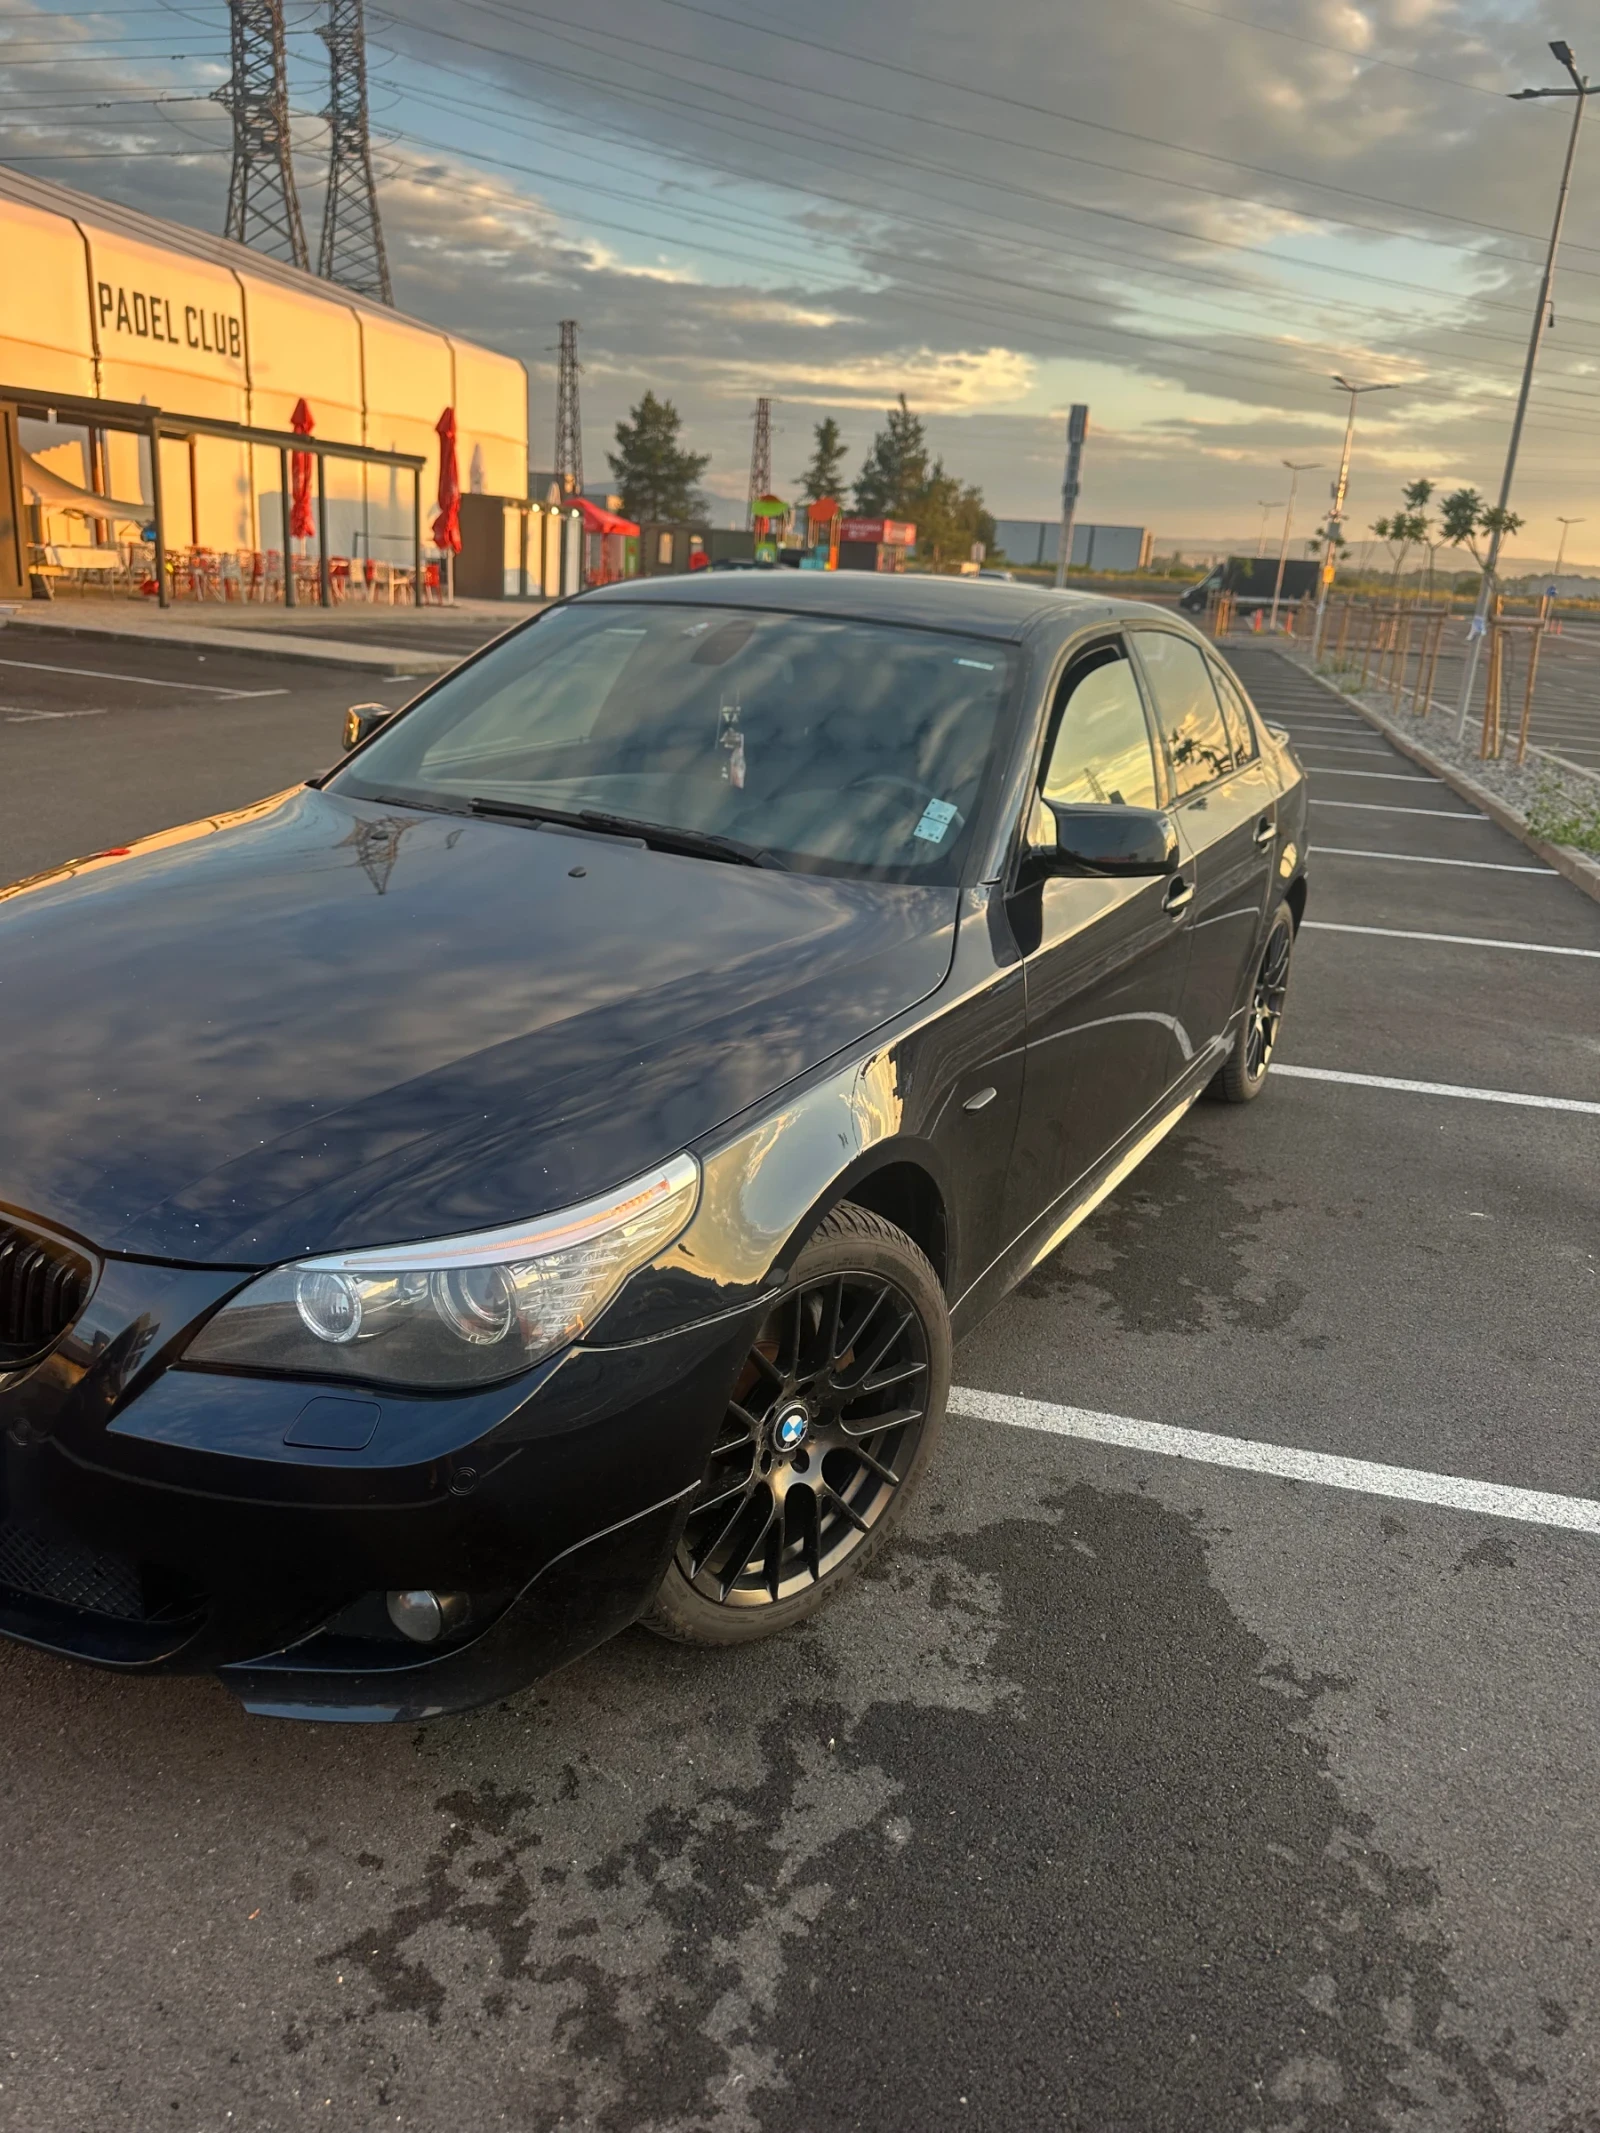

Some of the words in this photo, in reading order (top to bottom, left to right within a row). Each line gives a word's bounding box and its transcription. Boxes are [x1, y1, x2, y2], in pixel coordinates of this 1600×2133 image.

[98, 281, 179, 344] PADEL
[185, 305, 241, 358] CLUB
[851, 1515, 896, 1574] PEAK
